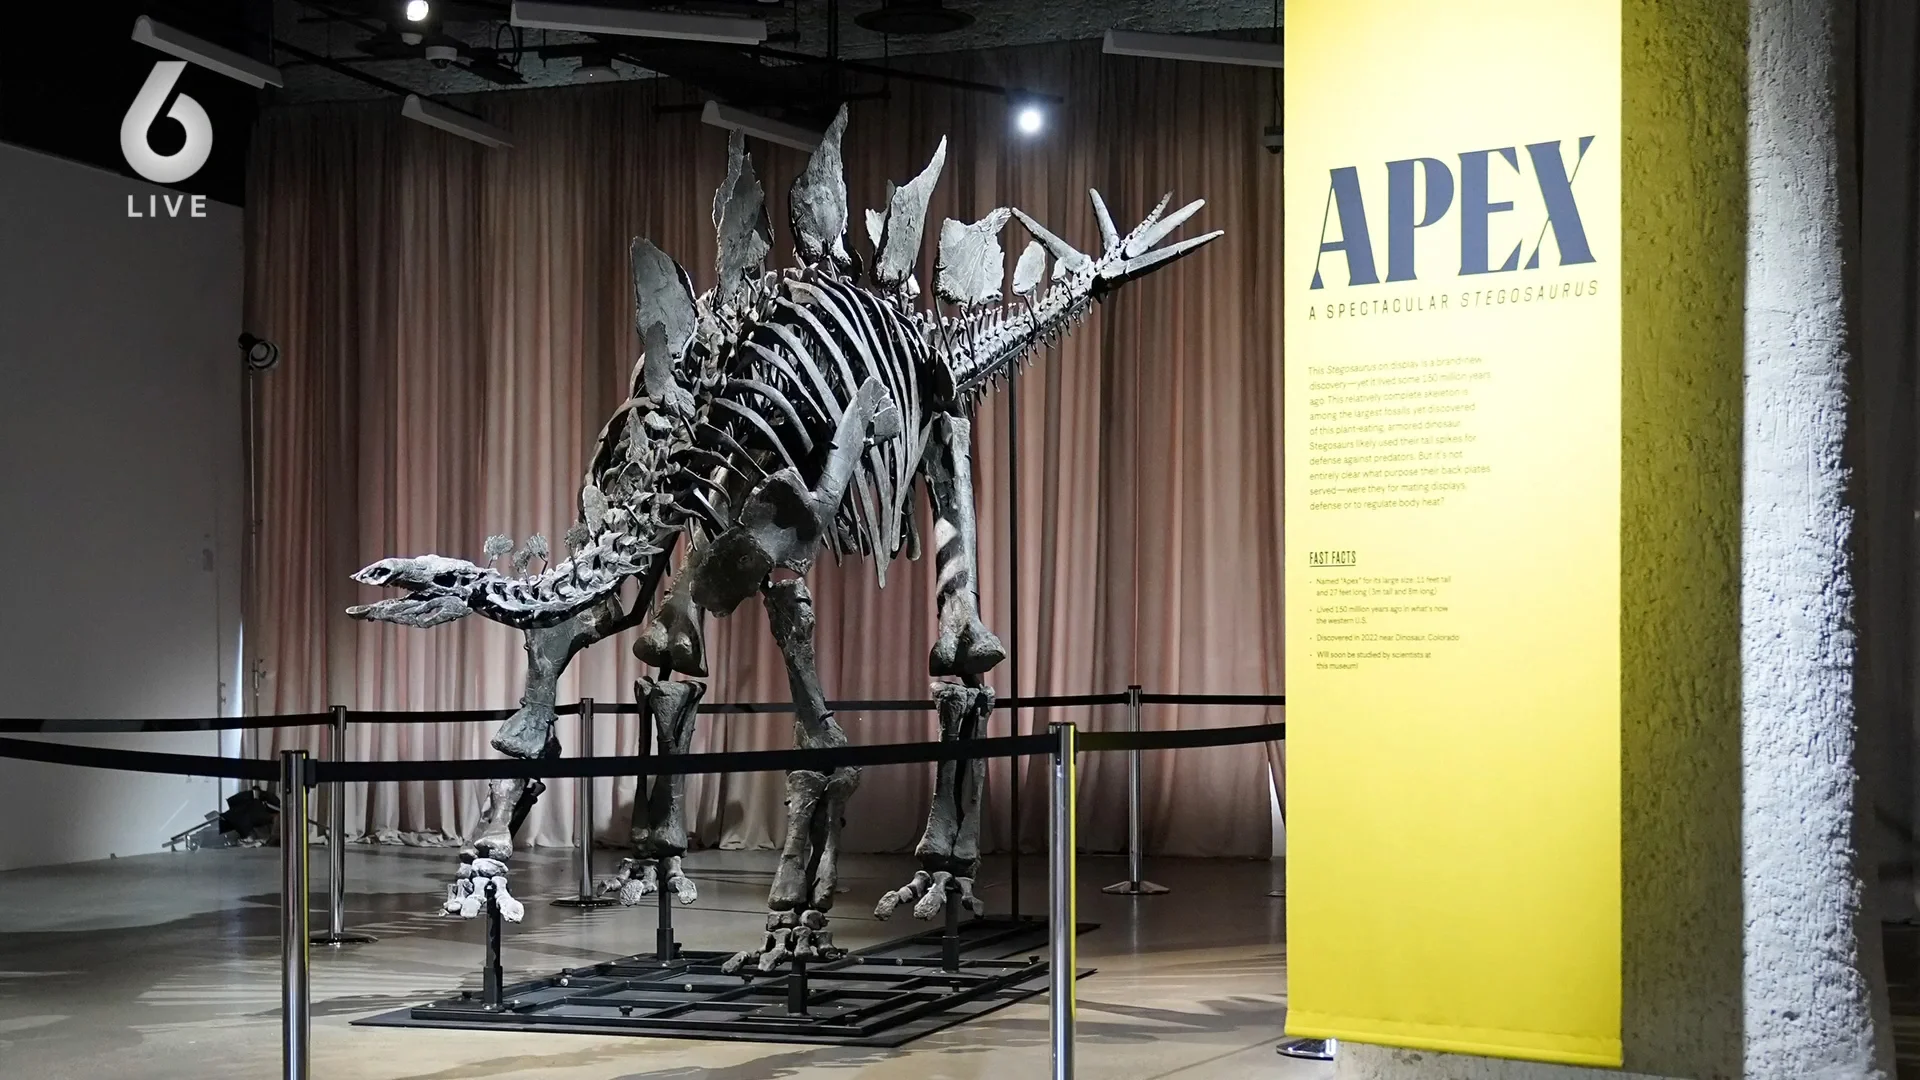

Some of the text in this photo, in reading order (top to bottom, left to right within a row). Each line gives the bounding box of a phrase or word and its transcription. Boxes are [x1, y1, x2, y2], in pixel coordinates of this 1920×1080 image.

[1309, 135, 1597, 290] APEX
[1309, 280, 1598, 320] A SPECTACULAR STEGOSAURUS
[1308, 366, 1324, 375] This
[1326, 364, 1376, 375] Stegosaurus
[1391, 360, 1419, 371] display
[1421, 359, 1428, 367] is
[1436, 356, 1482, 366] brand-new
[1370, 378, 1376, 386] it
[1377, 376, 1396, 386] lived
[1422, 374, 1438, 383] 150
[1439, 372, 1467, 382] million
[1469, 373, 1491, 383] years
[1328, 394, 1344, 403] This
[1345, 392, 1381, 403] relatively
[1383, 390, 1421, 402] complete
[1424, 388, 1460, 398] skeleton
[1461, 387, 1468, 395] is
[1309, 402, 1476, 421] among the largest fossils yet discovered
[1309, 427, 1318, 435] of
[1320, 426, 1334, 435] this
[1388, 421, 1422, 431] armored
[1309, 434, 1476, 452] Stegosaurs likely used their tail spikes for
[1309, 456, 1341, 465] defense
[1344, 454, 1372, 466] against
[1419, 451, 1432, 460] But
[1449, 450, 1463, 458] not
[1309, 465, 1491, 482] entirely clear what purpose their back plates
[1368, 484, 1385, 495] they
[1387, 484, 1399, 492] for
[1401, 482, 1429, 493] mating
[1309, 501, 1341, 510] defense
[1353, 501, 1361, 509] to
[1364, 499, 1397, 511] regulate
[1399, 498, 1420, 509] body
[1422, 497, 1444, 506] heat?
[1309, 550, 1356, 565] FAST FACTS
[1363, 576, 1372, 584] for
[1373, 576, 1381, 584] its
[1382, 576, 1399, 586] large
[1353, 588, 1367, 598] long
[1383, 588, 1393, 596] tall
[1420, 588, 1437, 597] long)
[1316, 605, 1334, 613] Lived
[1335, 605, 1348, 613] 150
[1349, 605, 1370, 613] million
[1371, 607, 1388, 615] years
[1390, 607, 1402, 615] ago
[1316, 650, 1329, 658] Will
[1347, 650, 1355, 658] be
[1356, 650, 1381, 658] studied
[1382, 650, 1390, 660] by
[1392, 650, 1424, 658] scientists
[1316, 662, 1359, 670] this museum!
